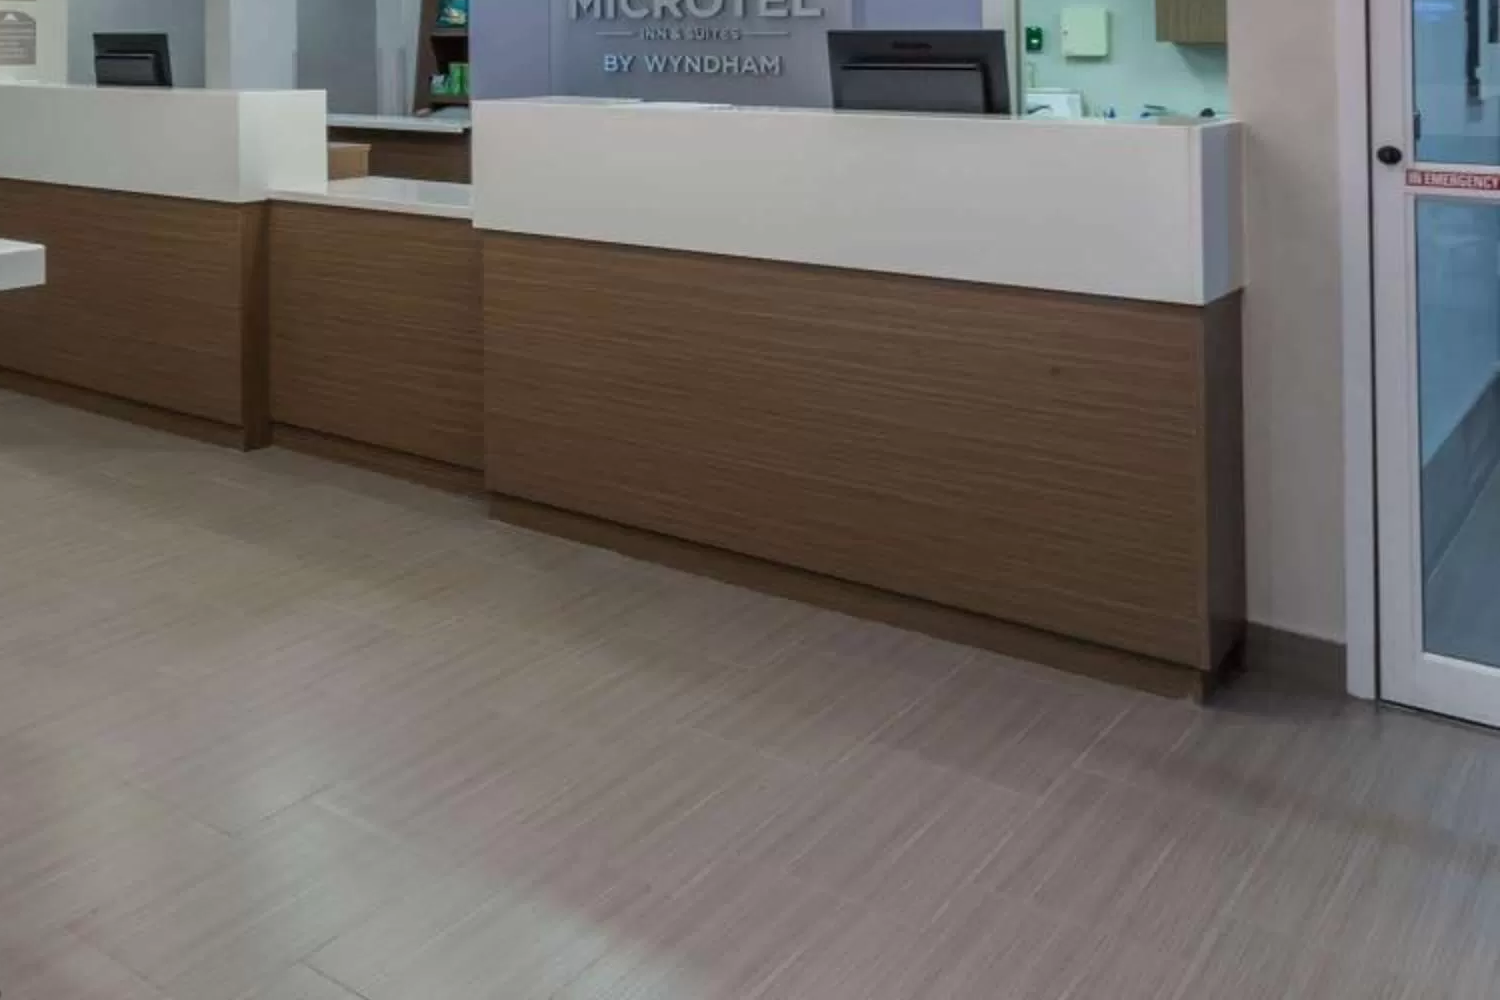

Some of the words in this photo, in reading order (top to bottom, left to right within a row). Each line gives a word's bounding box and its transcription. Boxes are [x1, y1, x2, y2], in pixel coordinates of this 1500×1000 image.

[640, 27, 667, 40] INN
[686, 27, 741, 40] SUITES
[603, 55, 633, 72] BY
[645, 55, 782, 75] WYNDHAM
